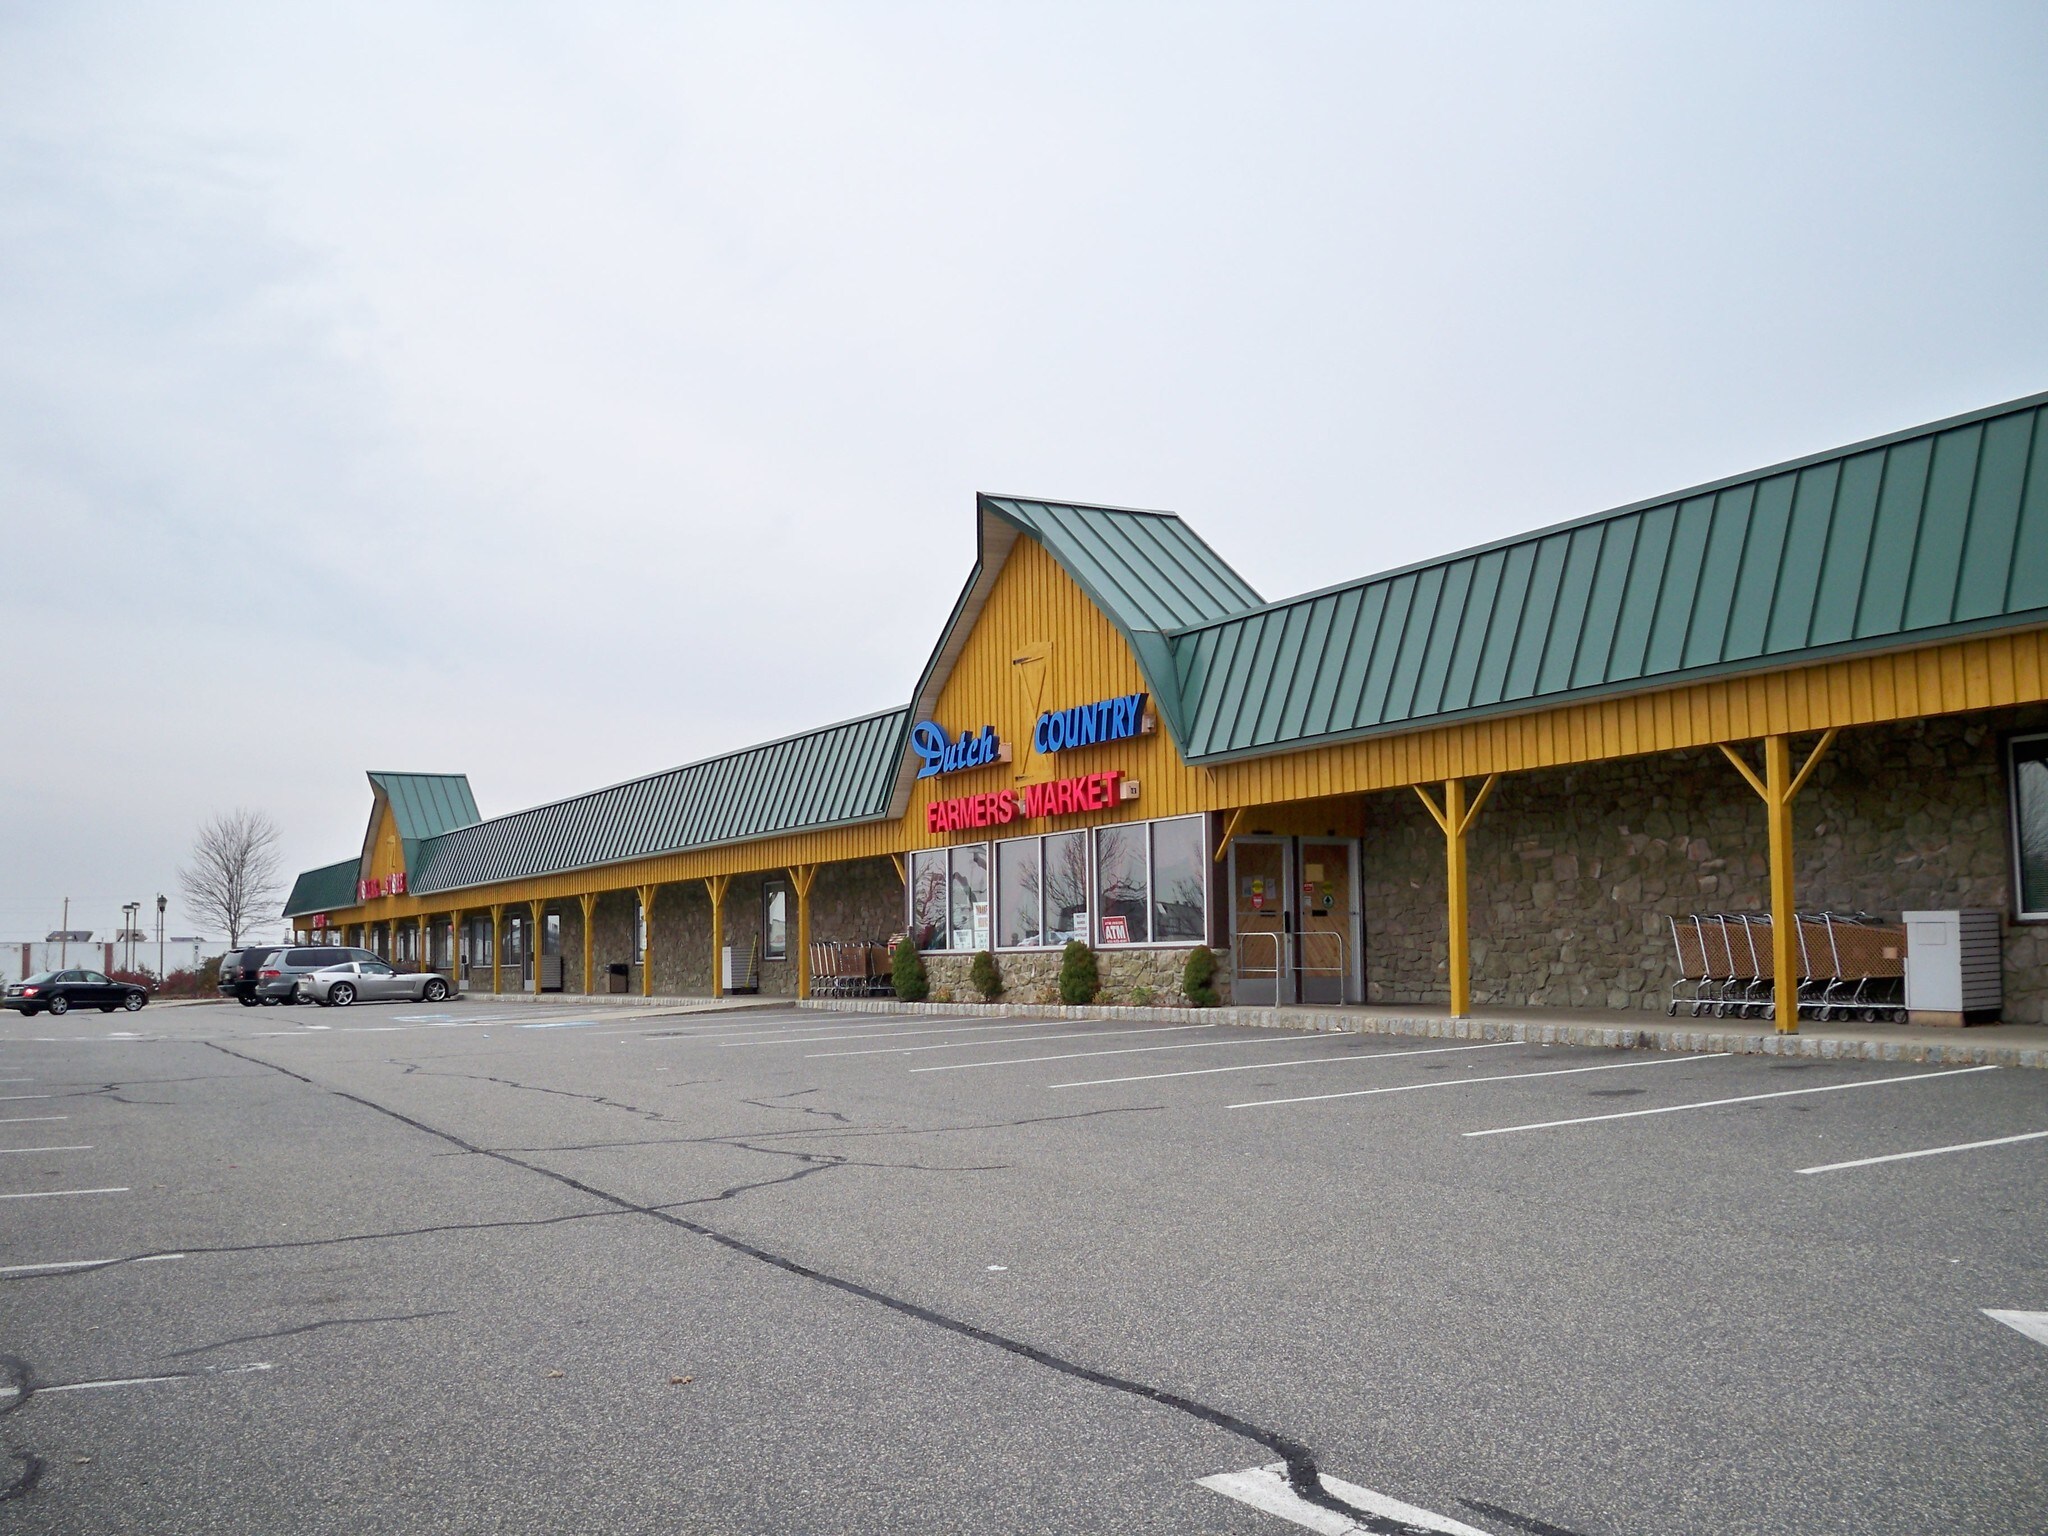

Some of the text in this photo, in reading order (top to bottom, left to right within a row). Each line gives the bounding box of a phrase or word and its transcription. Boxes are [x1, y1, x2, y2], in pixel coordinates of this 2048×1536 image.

[911, 693, 1148, 779] Dutch COUNTRY
[927, 771, 1125, 834] FARMERS MARKET
[1105, 925, 1126, 940] ATM
